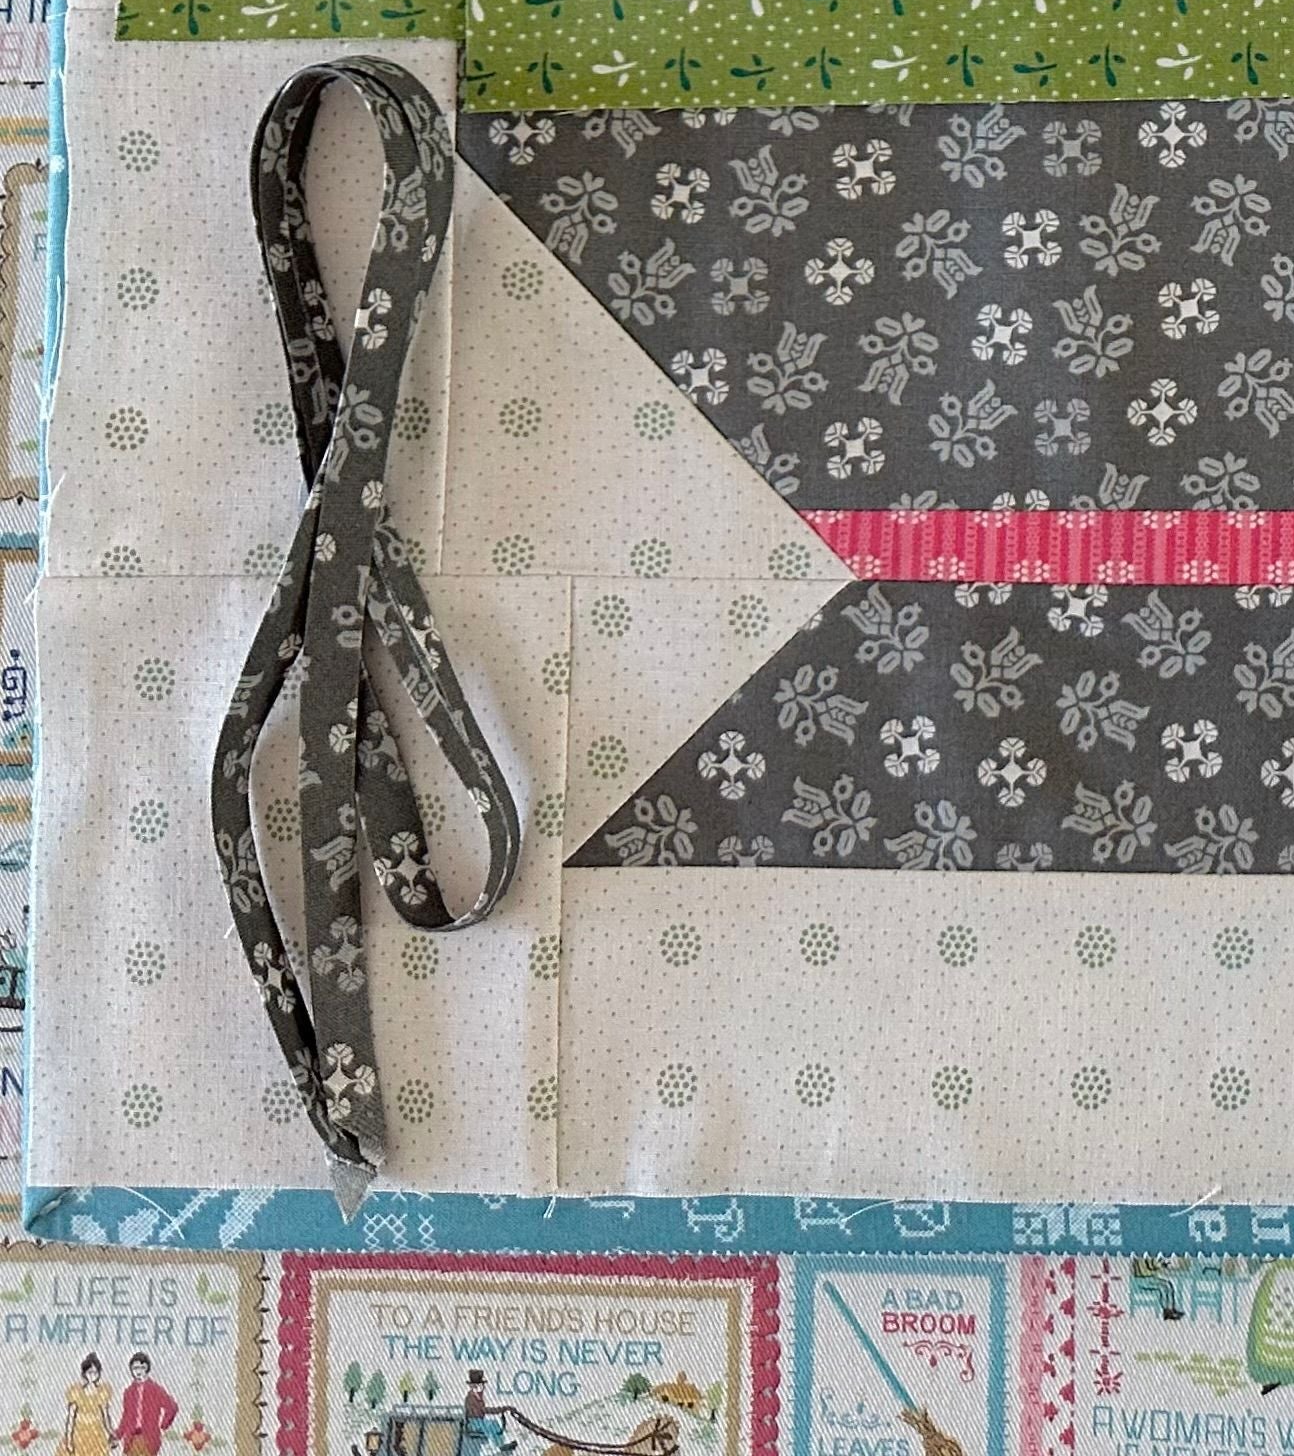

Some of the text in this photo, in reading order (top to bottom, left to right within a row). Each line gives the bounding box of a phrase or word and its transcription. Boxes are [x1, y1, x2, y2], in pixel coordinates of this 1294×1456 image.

[882, 1288, 963, 1311] A BAD
[371, 1304, 695, 1337] TO A FRIEND'S HOUSE
[882, 1312, 976, 1335] BROOM
[382, 1335, 664, 1366] THE WAY IS NEVER
[497, 1370, 580, 1397] LONG
[1092, 1406, 1113, 1438] A
[1122, 1408, 1266, 1440] WOMAN'S
